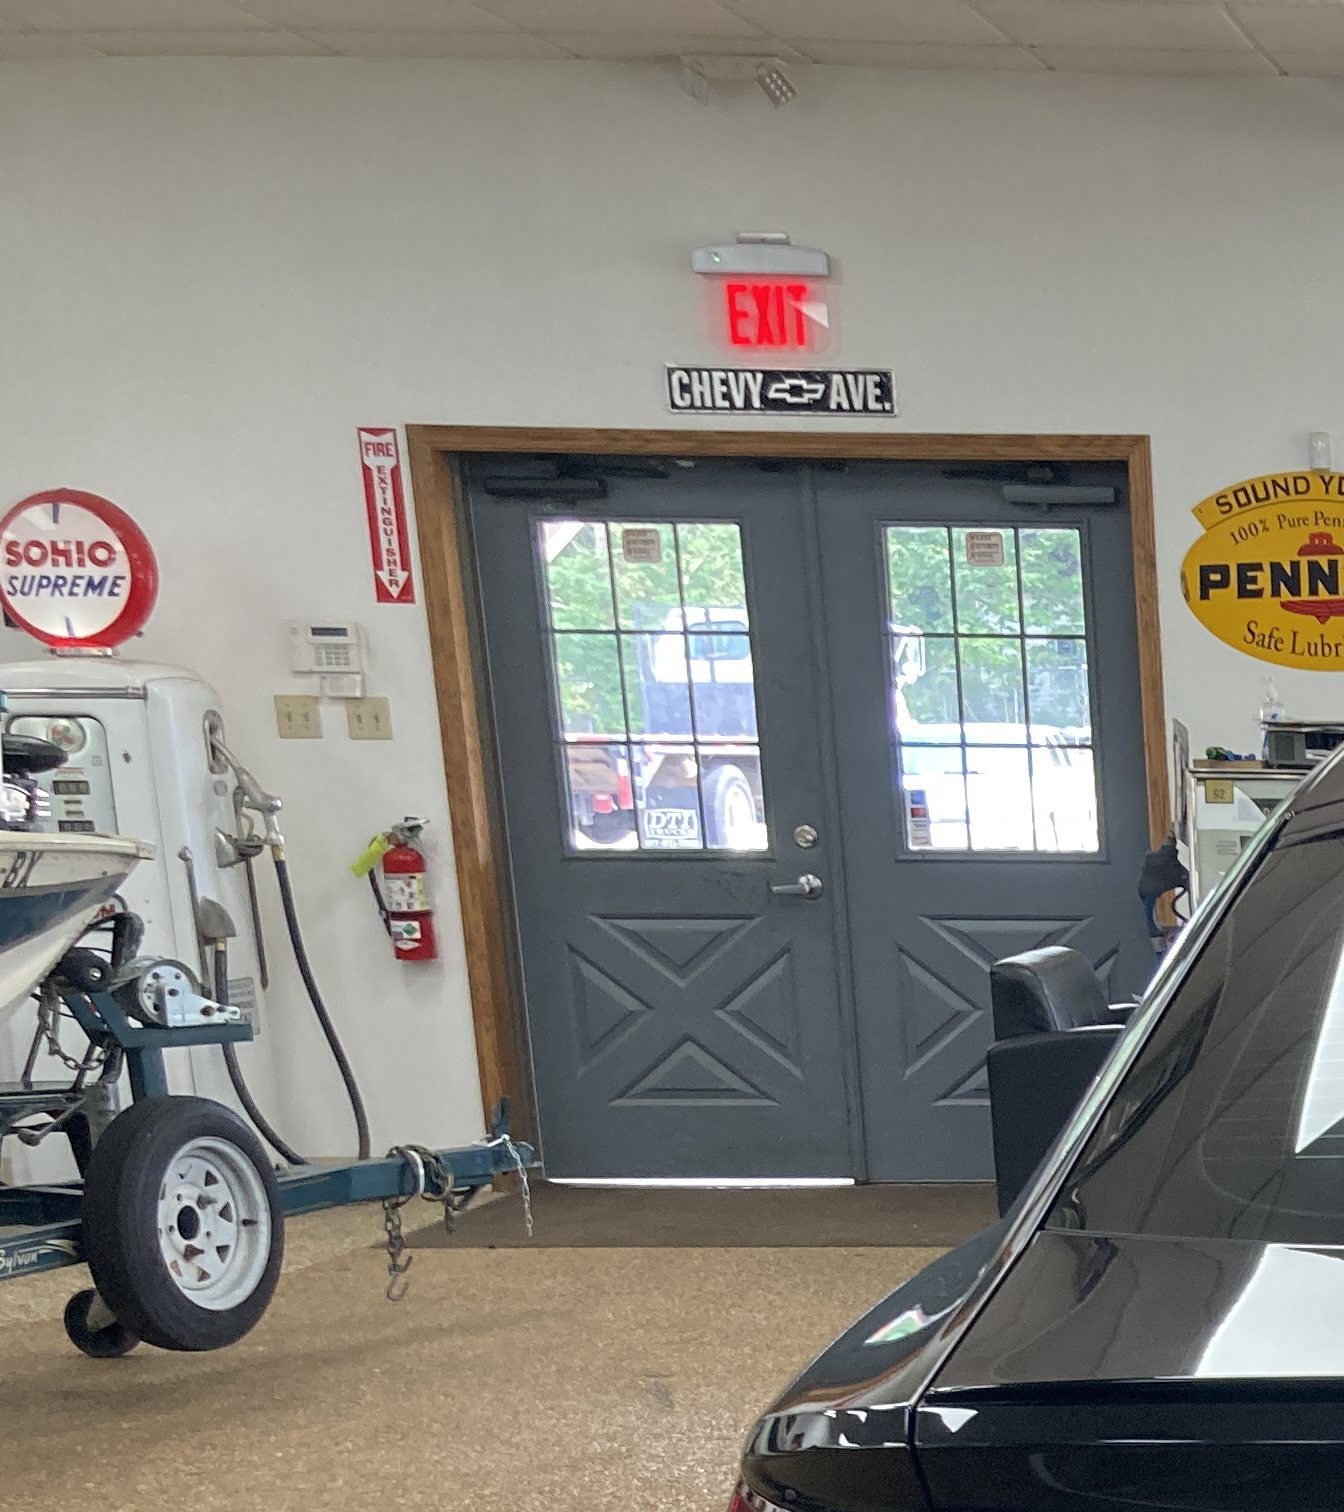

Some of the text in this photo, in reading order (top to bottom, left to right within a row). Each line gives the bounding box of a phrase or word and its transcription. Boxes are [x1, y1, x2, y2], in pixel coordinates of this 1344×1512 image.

[725, 283, 807, 346] EXIT
[670, 370, 892, 411] CHEVY AVE.
[364, 441, 394, 458] FIRE
[1215, 475, 1311, 514] SOUND
[377, 465, 401, 588] EXTINGUISHER
[1230, 519, 1270, 546] 100%
[1276, 513, 1310, 530] Pure
[5, 540, 117, 568] SOHIO
[6, 575, 127, 598] SUPREME
[1243, 619, 1284, 652] Safe
[648, 812, 692, 829] DTI
